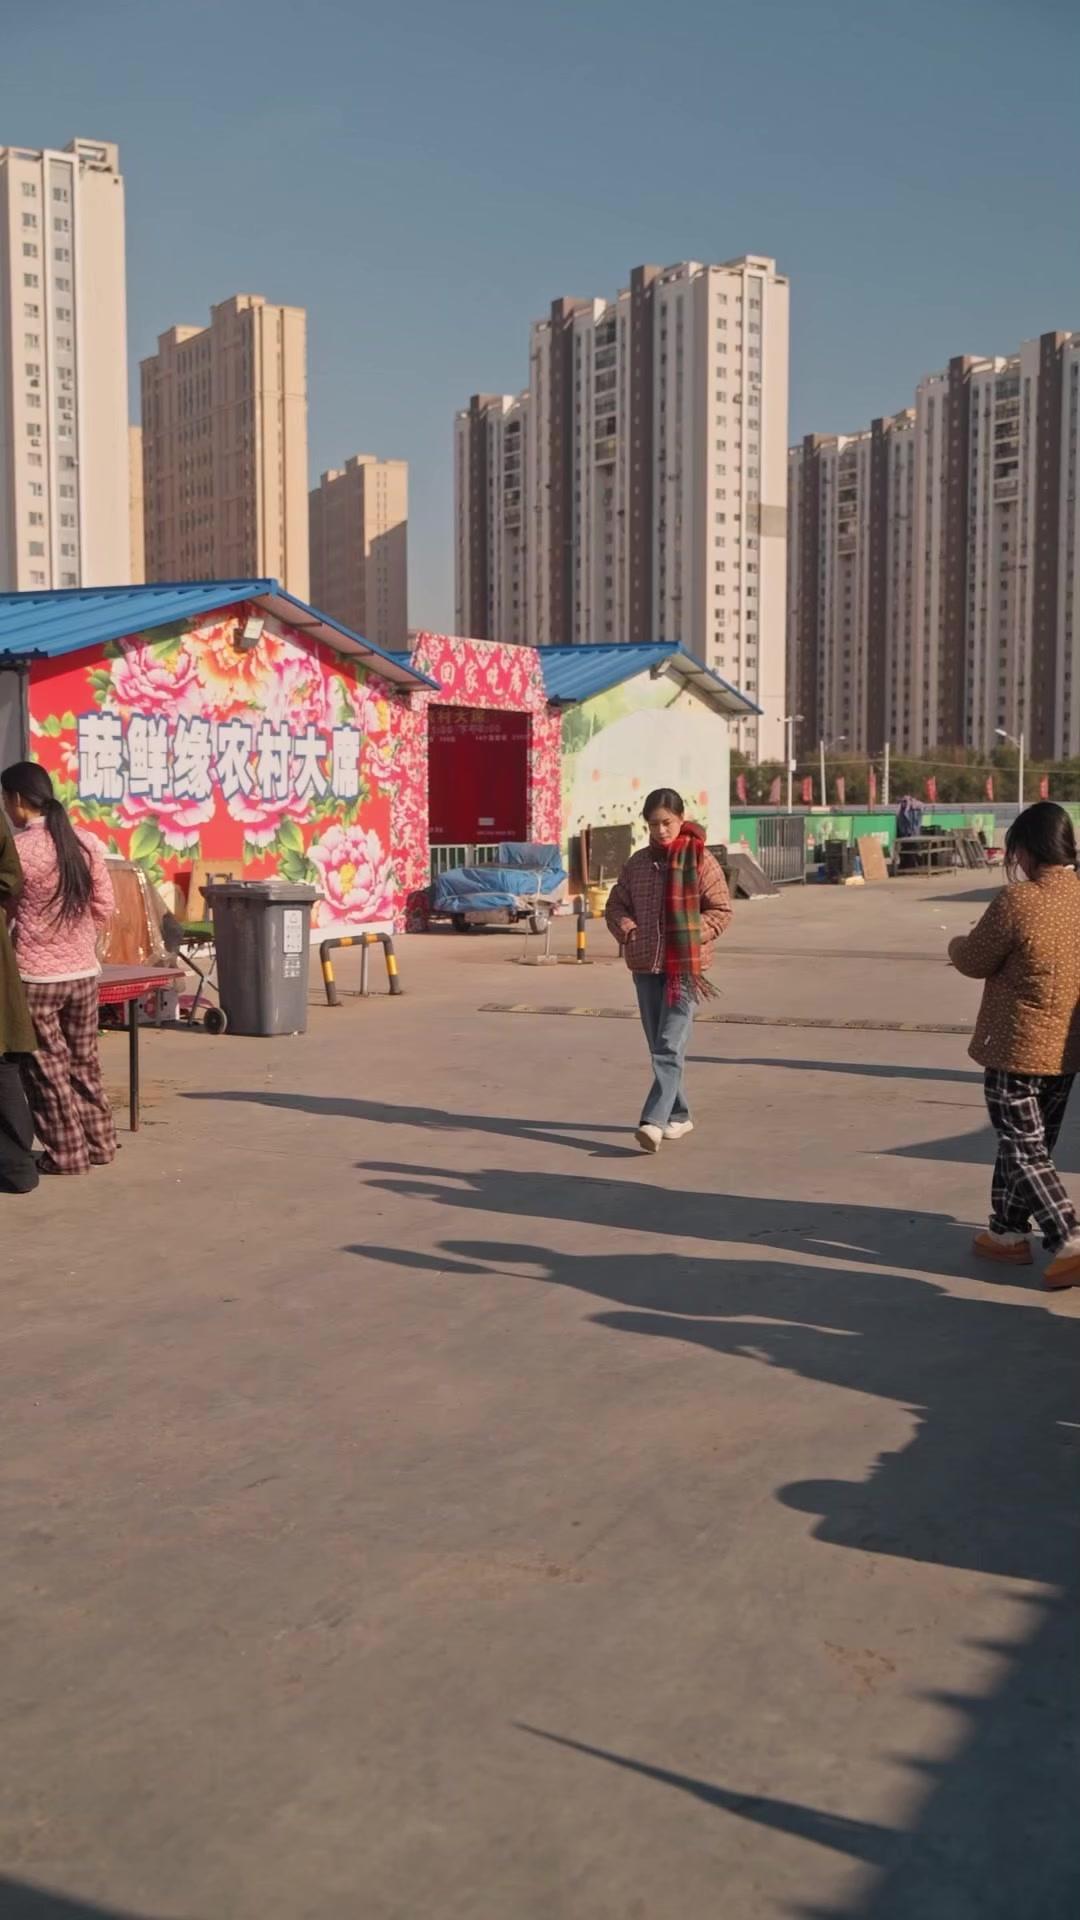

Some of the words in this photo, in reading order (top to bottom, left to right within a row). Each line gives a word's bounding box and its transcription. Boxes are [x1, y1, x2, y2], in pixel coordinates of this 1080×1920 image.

[78, 712, 361, 803] 蔬鲜缘农村大席
